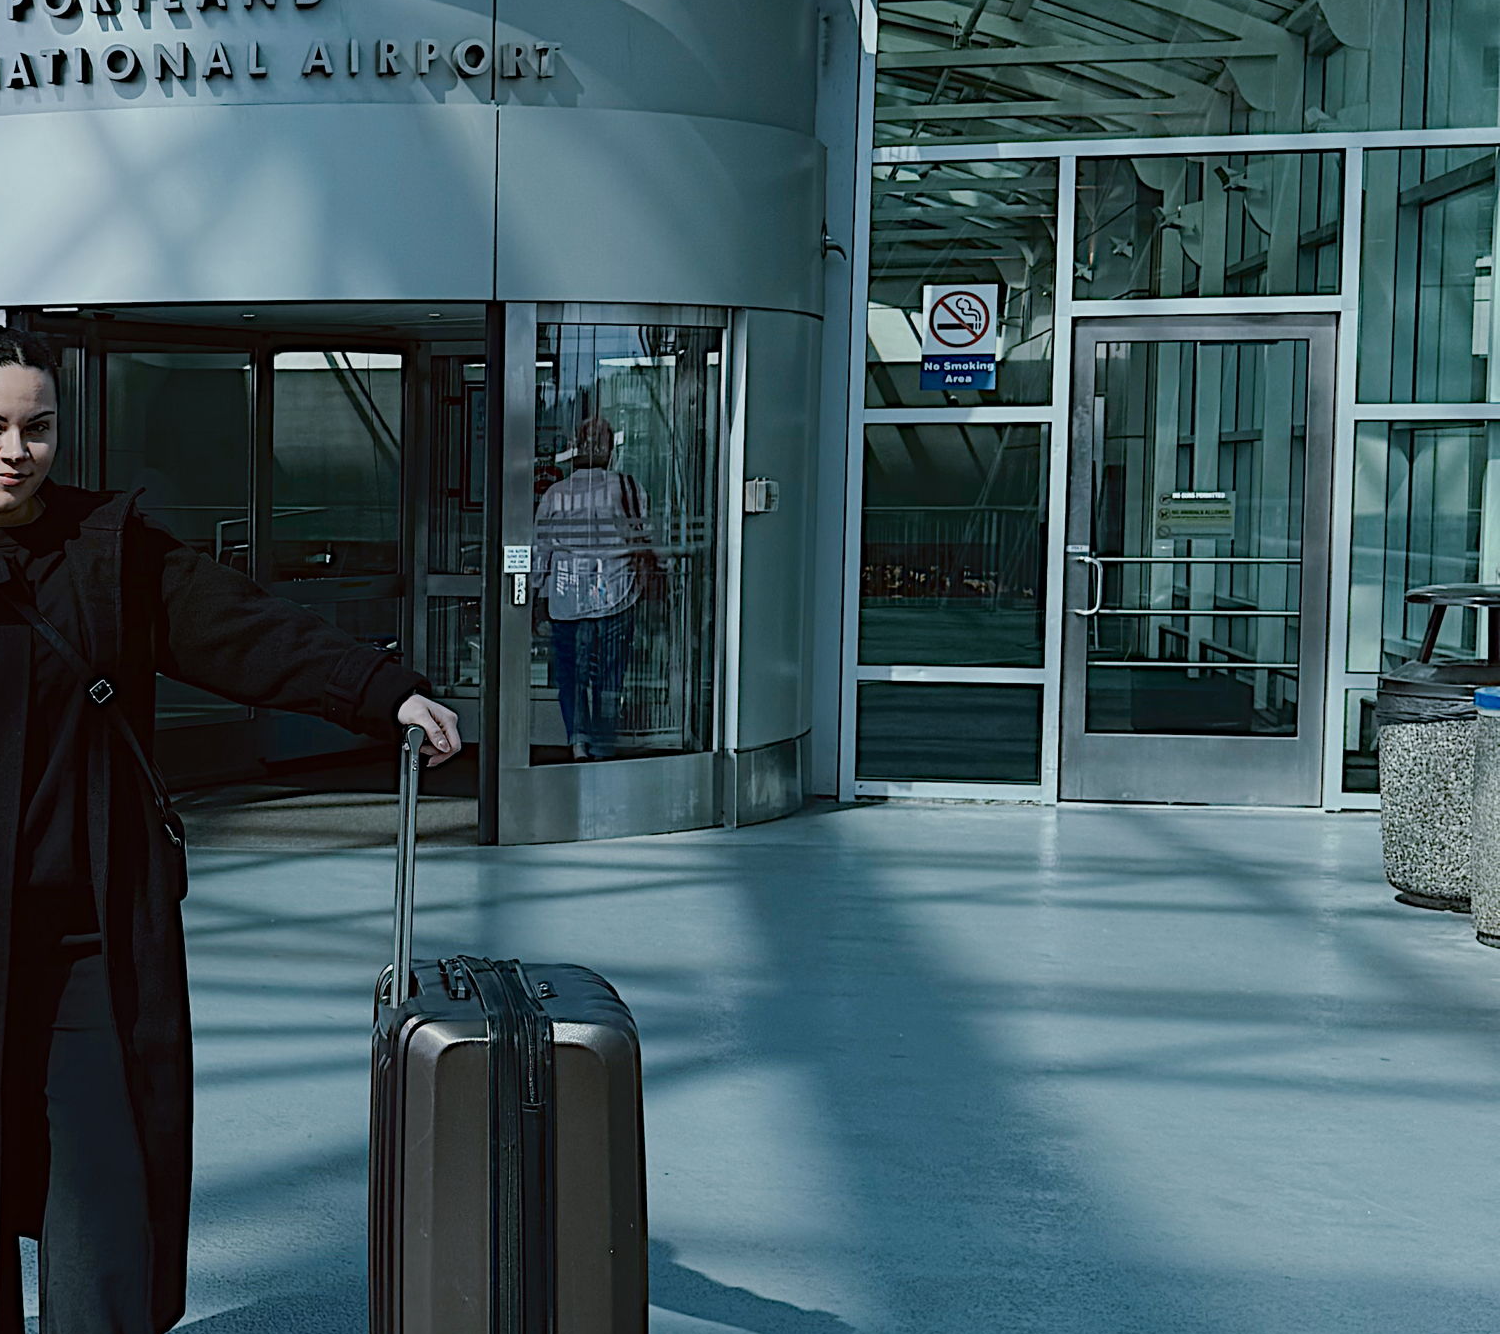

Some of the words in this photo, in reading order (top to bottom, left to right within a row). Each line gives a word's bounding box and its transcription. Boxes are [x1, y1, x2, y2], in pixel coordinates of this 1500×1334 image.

[302, 38, 563, 78] AIRPORT
[924, 362, 940, 371] No
[943, 361, 995, 371] Smoking
[945, 374, 972, 383] Area
